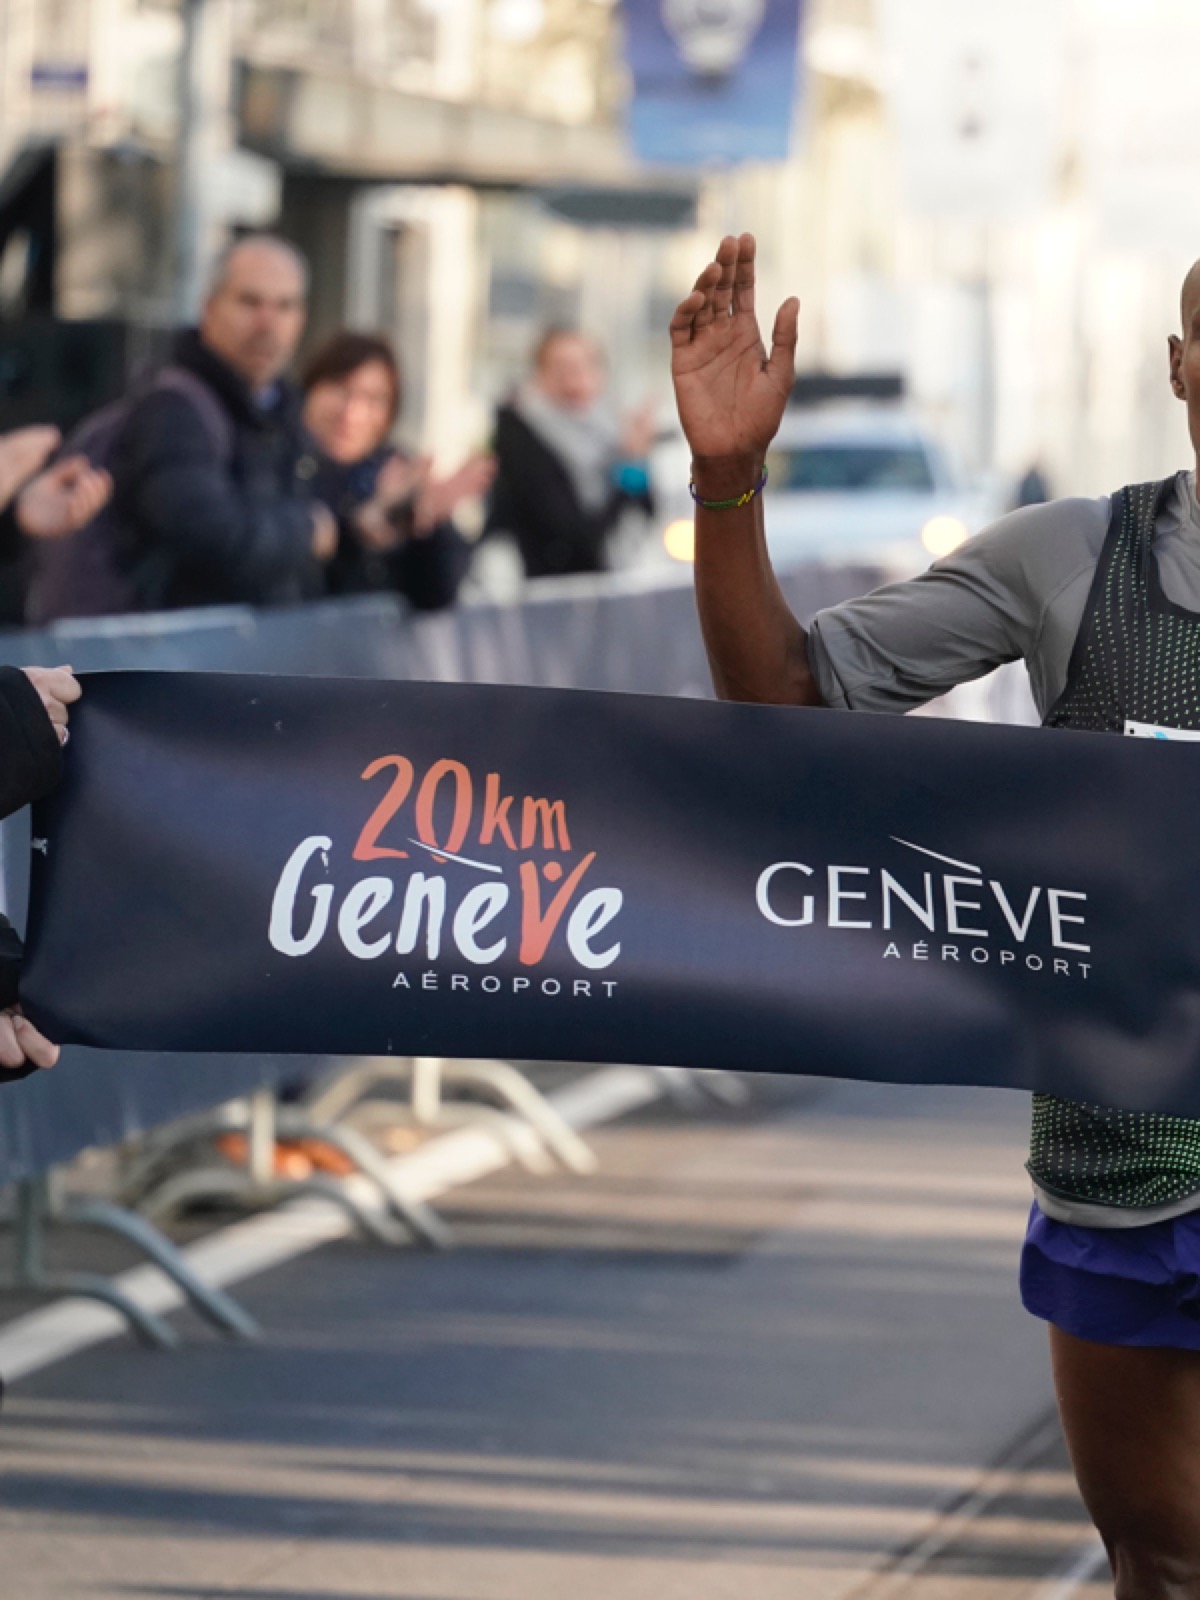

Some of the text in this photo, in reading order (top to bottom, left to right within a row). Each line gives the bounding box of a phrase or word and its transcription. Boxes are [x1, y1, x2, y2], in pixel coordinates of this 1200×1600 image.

[755, 836, 1092, 953] GENÈVE
[881, 939, 1092, 979] AÉROPORT
[392, 970, 619, 998] AÉROPORT
